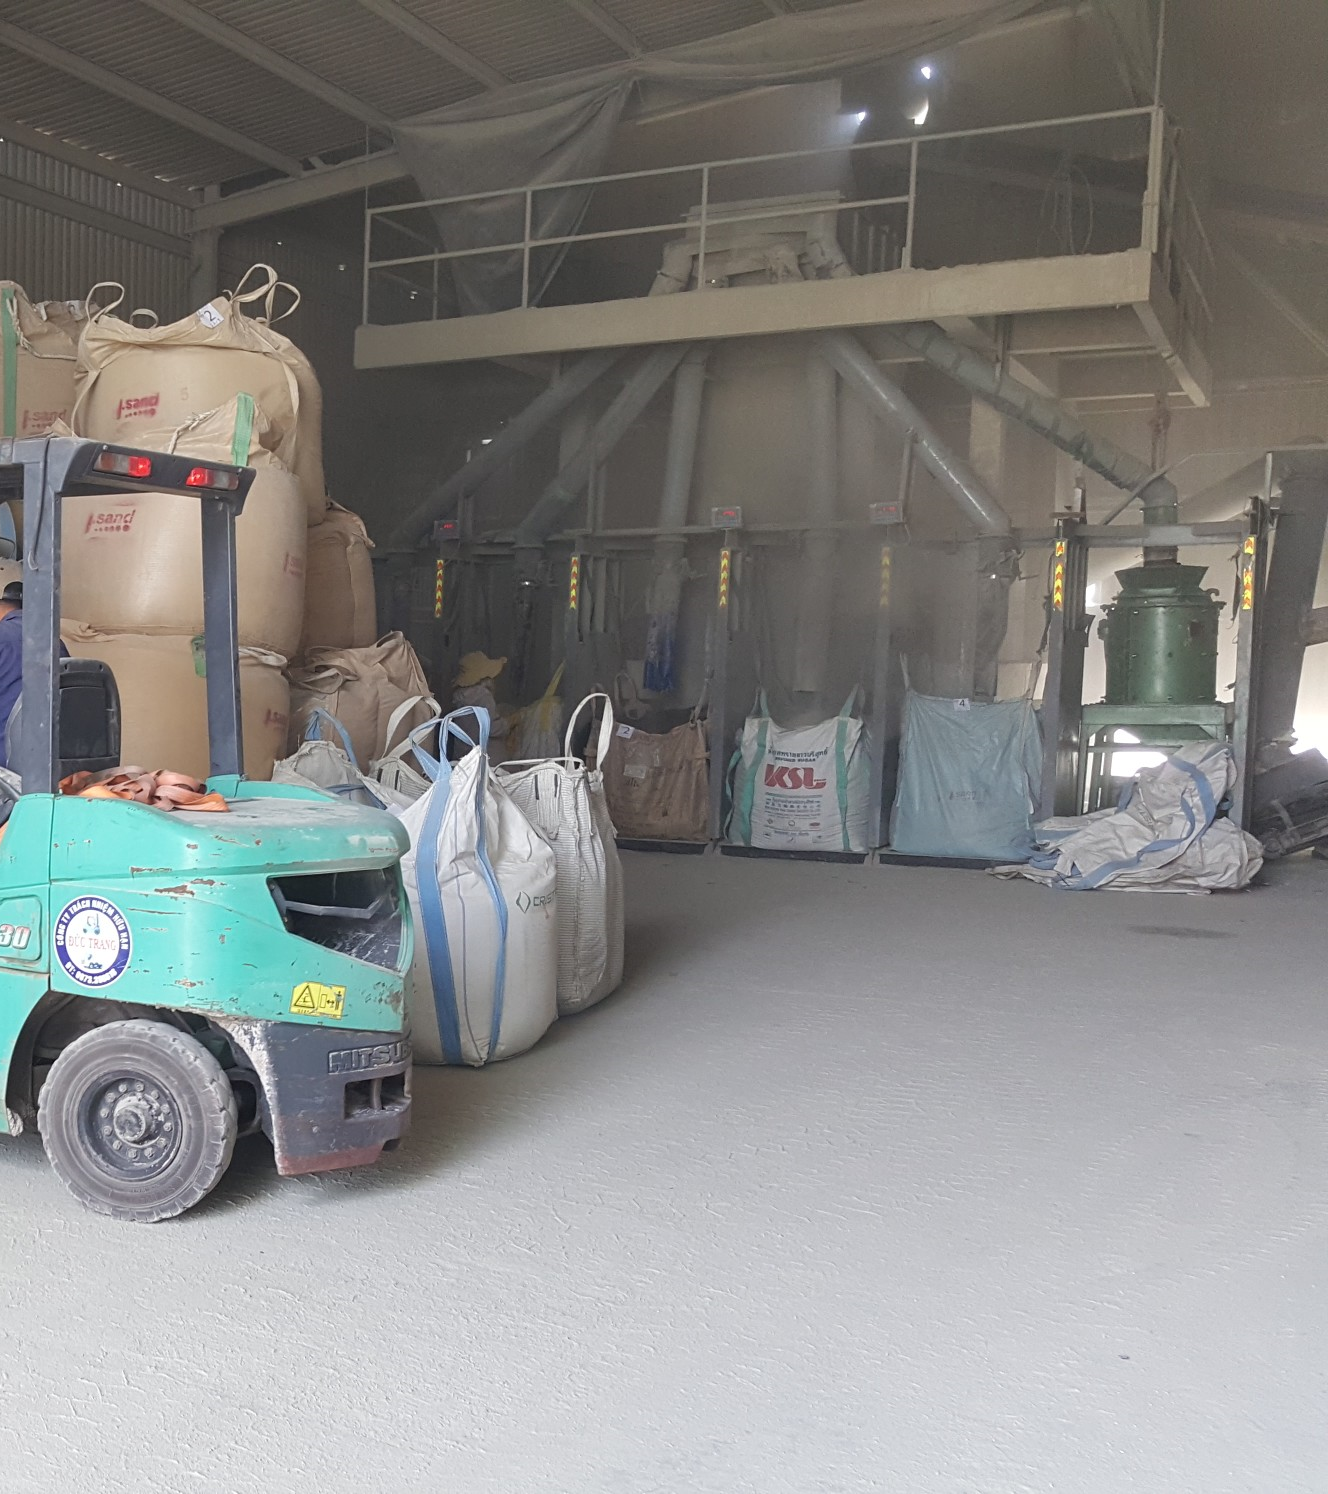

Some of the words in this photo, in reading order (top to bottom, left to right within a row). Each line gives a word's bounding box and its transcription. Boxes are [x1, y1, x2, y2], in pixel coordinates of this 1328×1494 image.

[203, 310, 217, 322] 2
[623, 726, 631, 735] 2
[764, 763, 826, 790] KSL
[88, 937, 117, 951] TRANG
